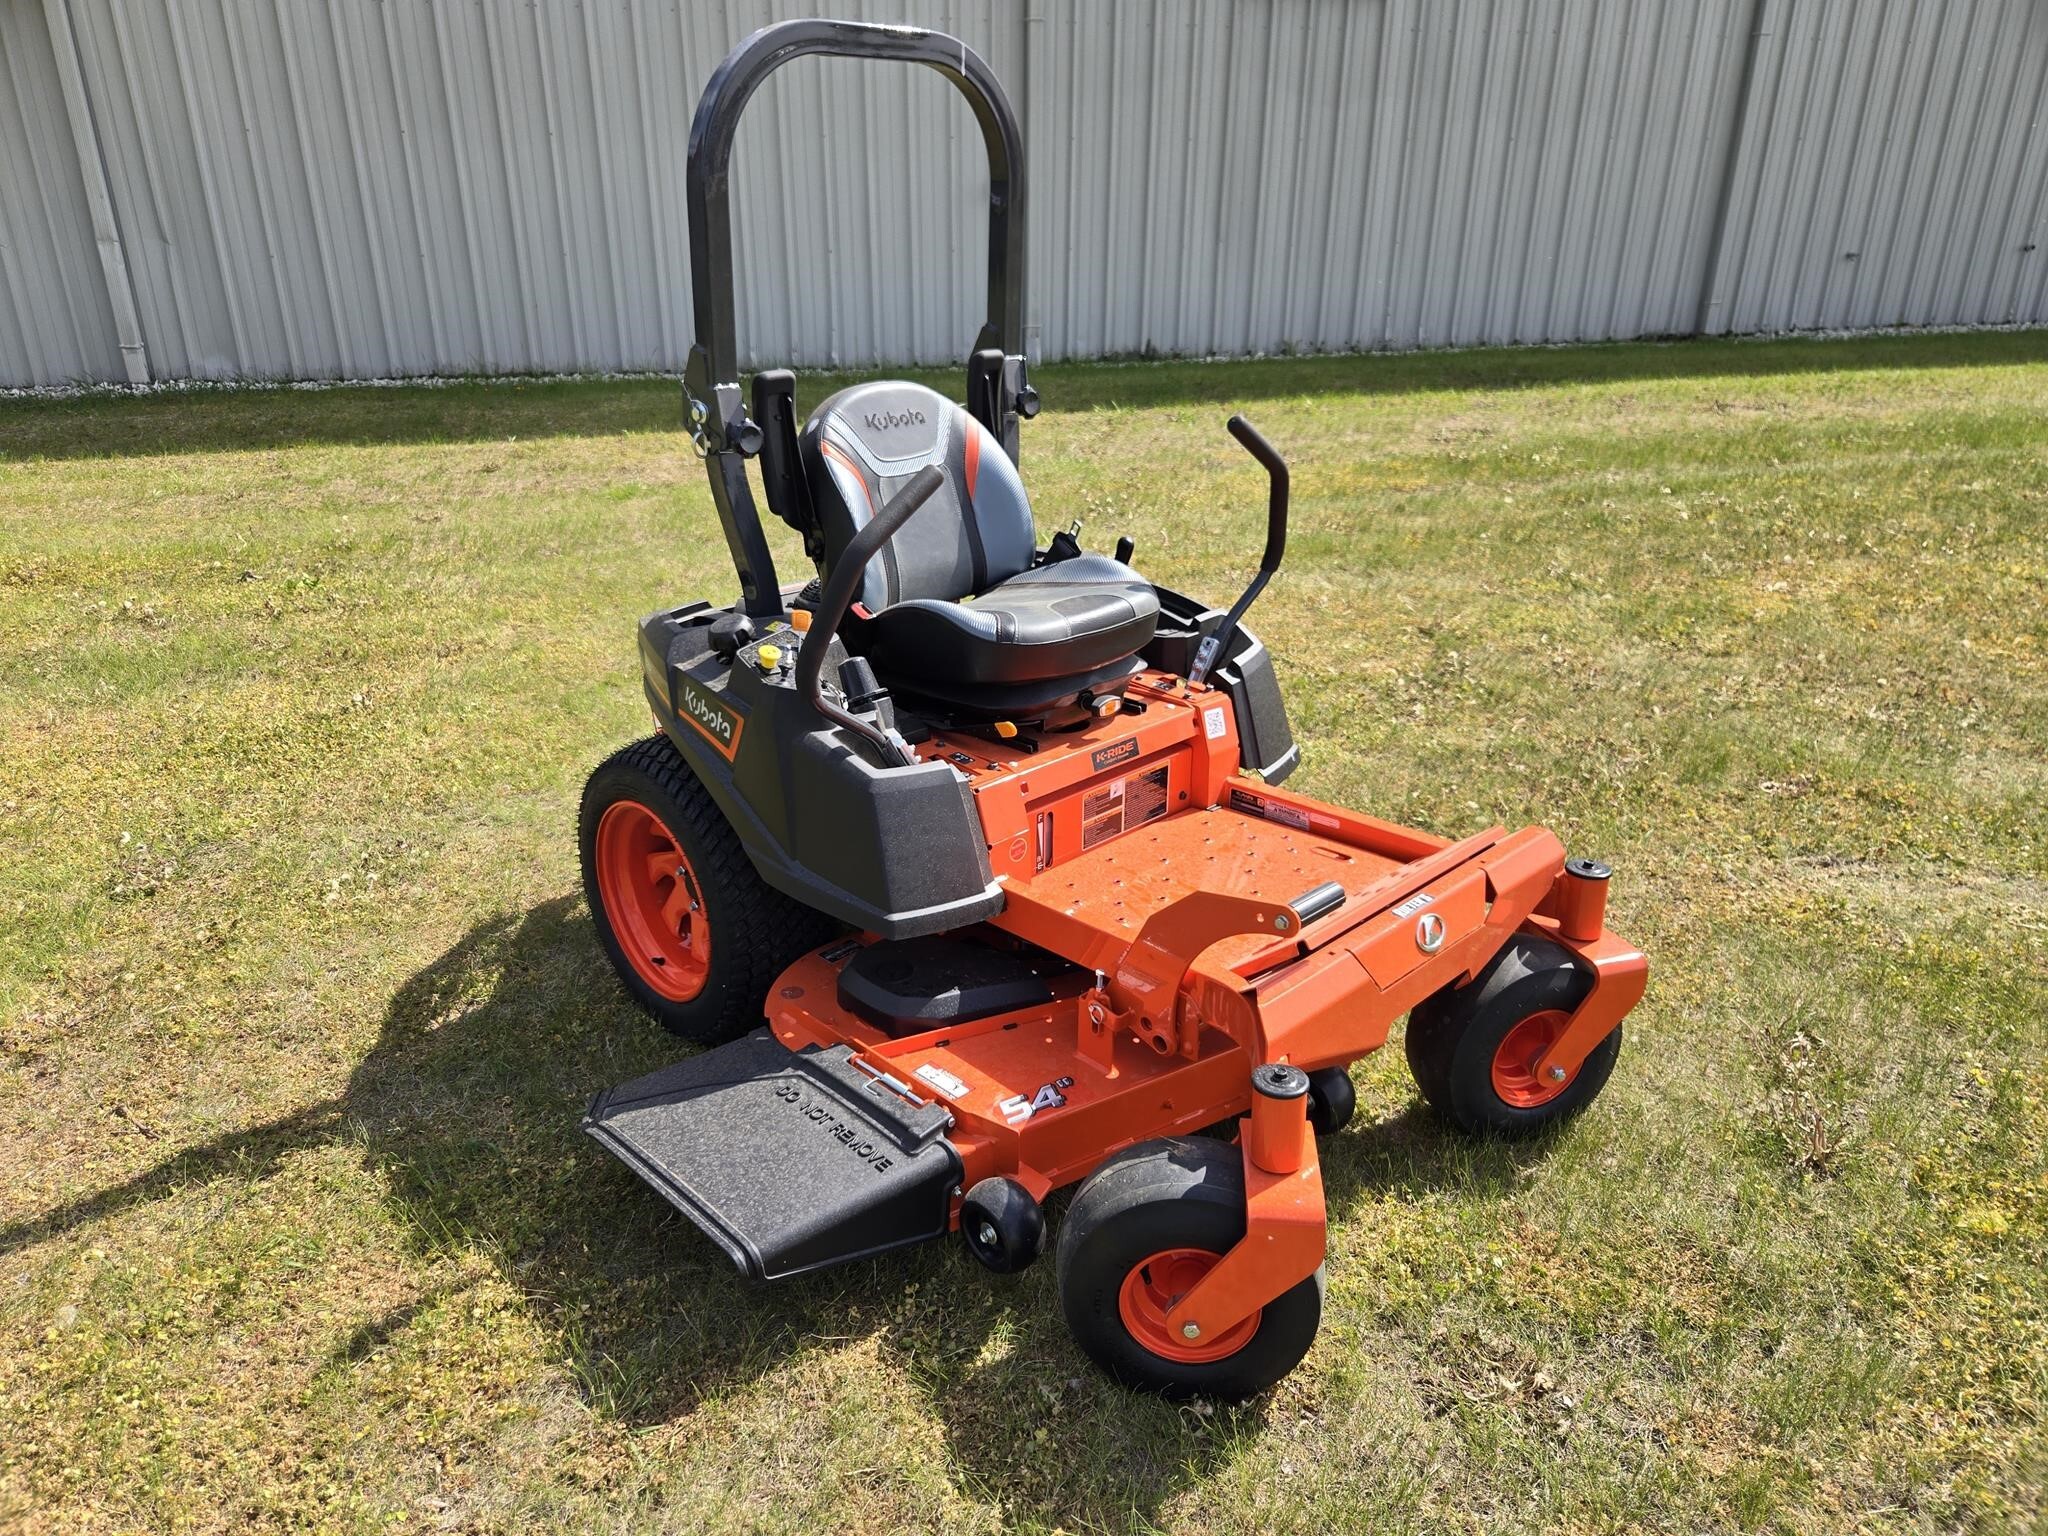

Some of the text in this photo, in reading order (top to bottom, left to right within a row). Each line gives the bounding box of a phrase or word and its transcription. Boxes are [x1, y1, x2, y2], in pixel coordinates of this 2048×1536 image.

[864, 408, 926, 431] Kubota
[685, 686, 731, 739] Kubota
[1096, 741, 1134, 763] K-RIDE
[775, 1086, 894, 1173] DO NOT REMOVE
